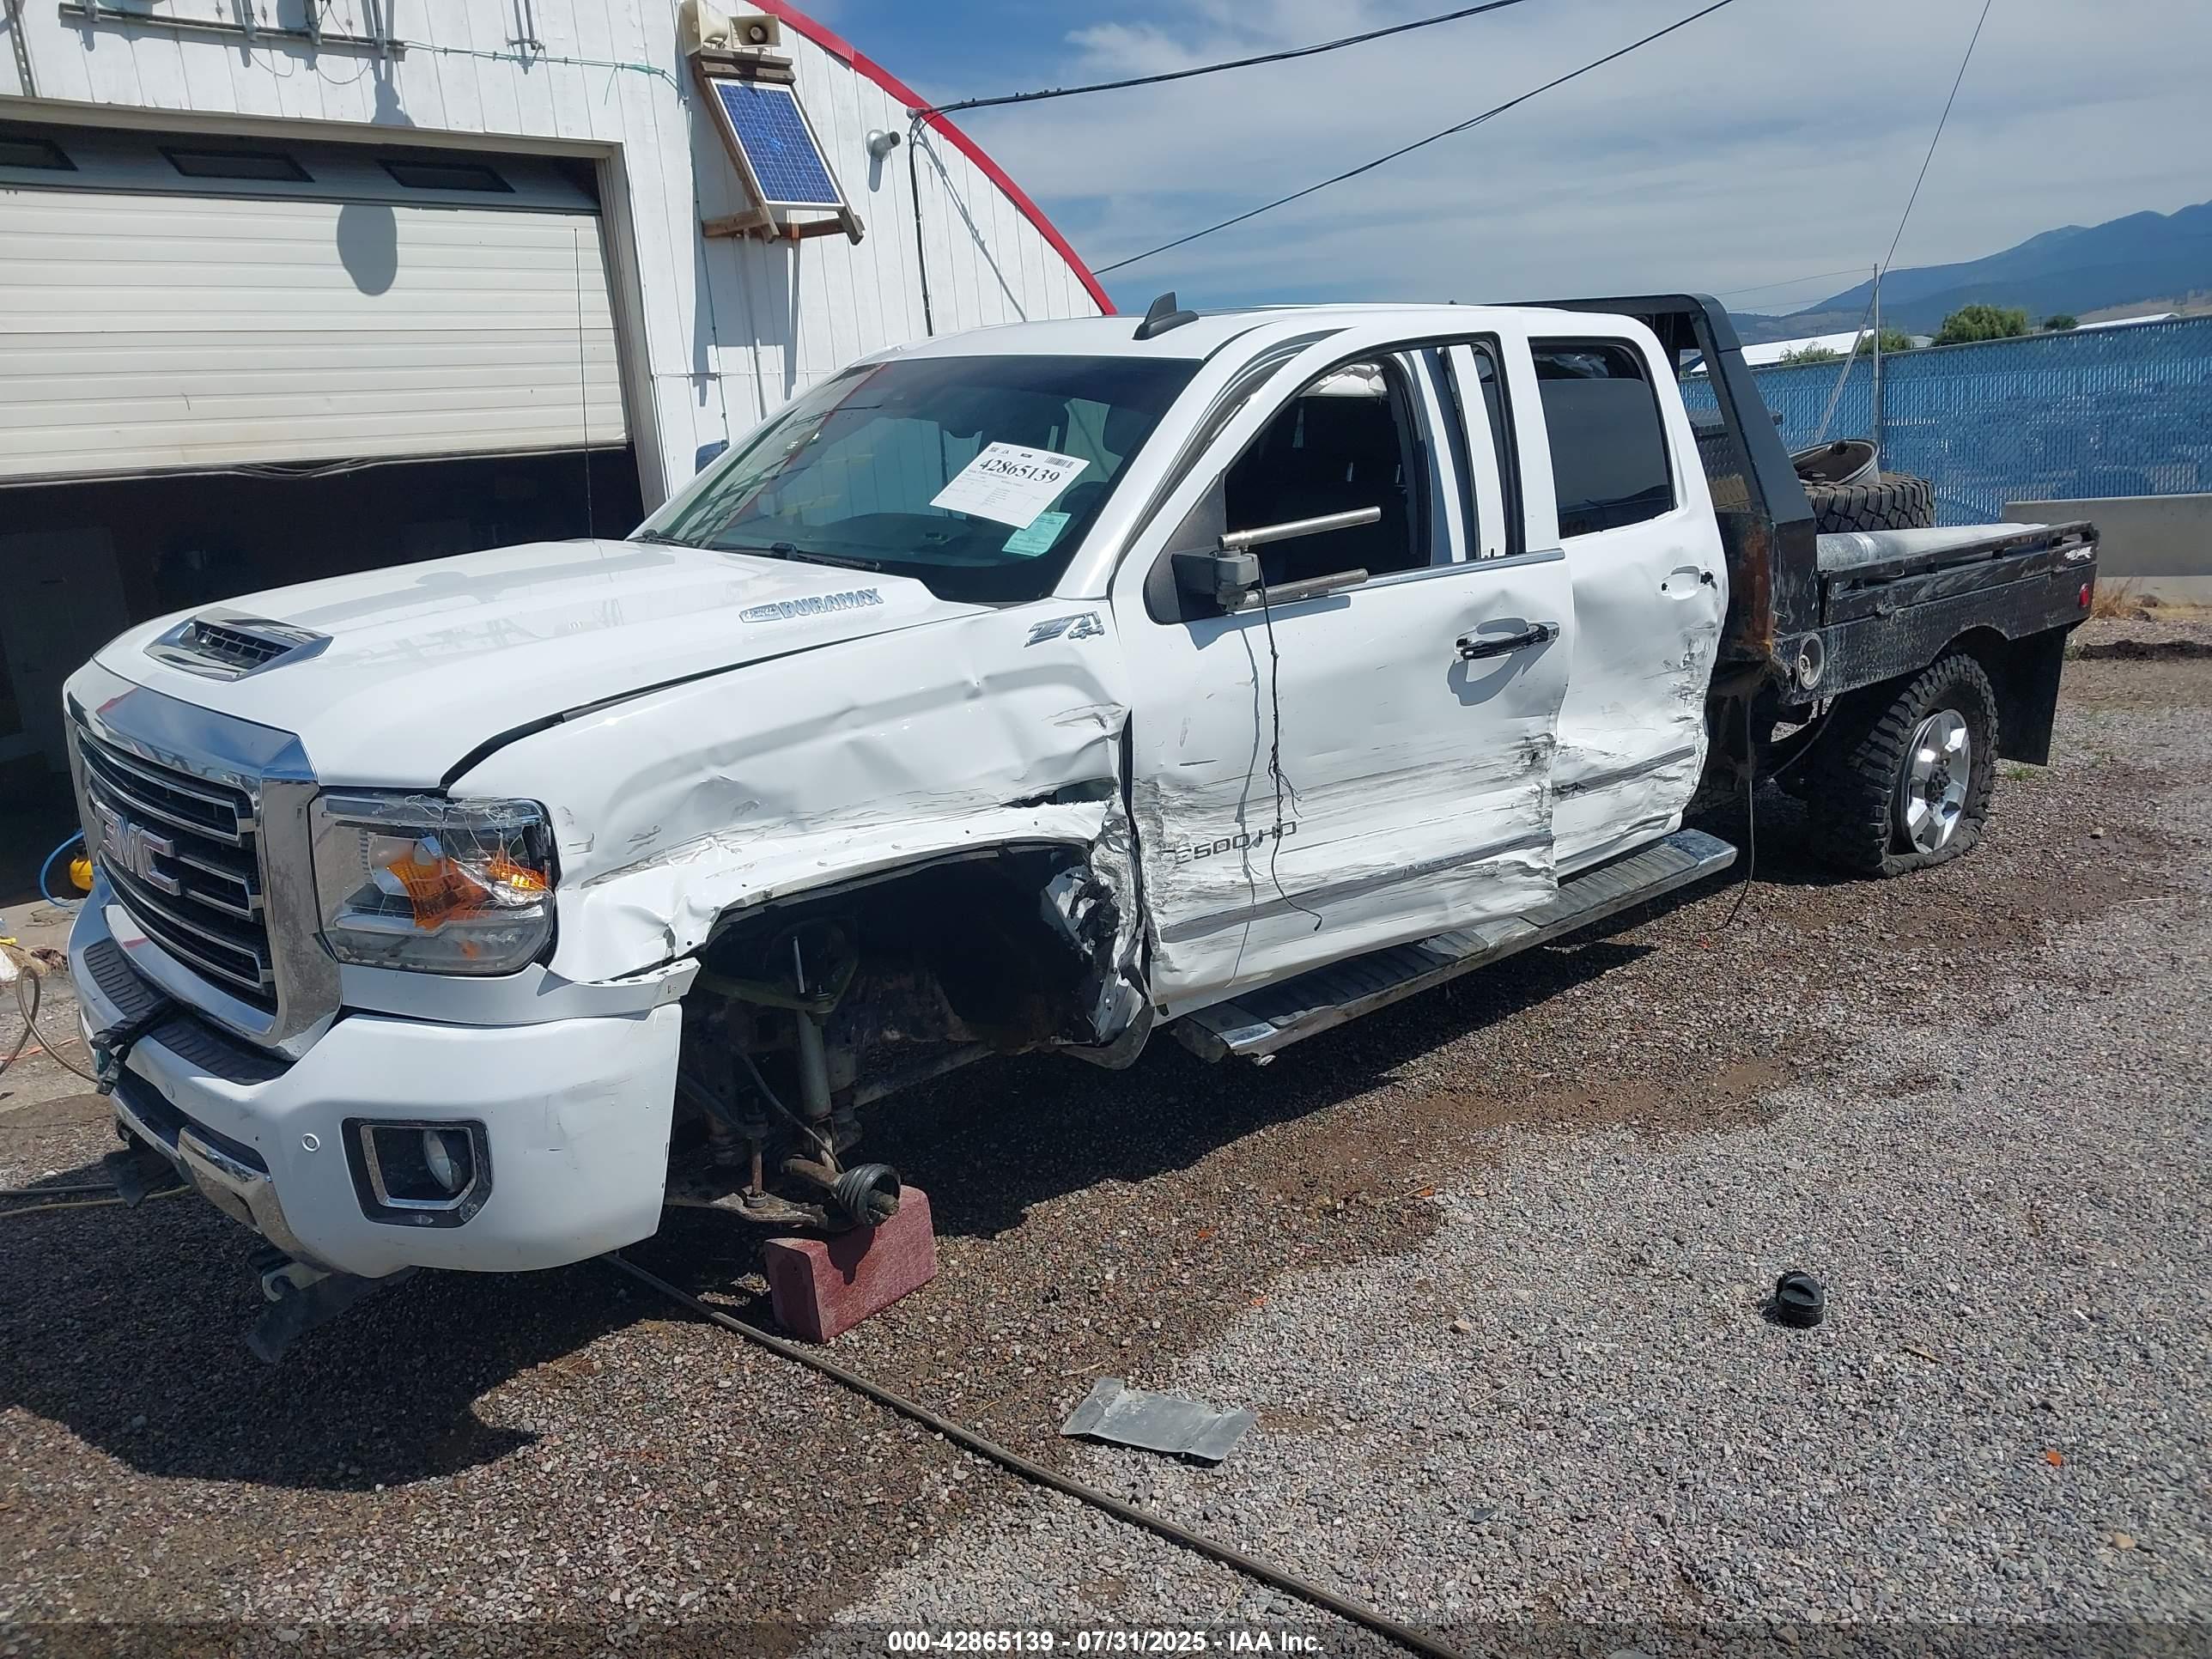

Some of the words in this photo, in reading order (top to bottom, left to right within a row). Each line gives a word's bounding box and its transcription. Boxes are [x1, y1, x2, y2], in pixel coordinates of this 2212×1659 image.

[979, 457, 1060, 484] 42865139
[778, 588, 884, 619] DURAMAX
[1258, 821, 1297, 843] HD
